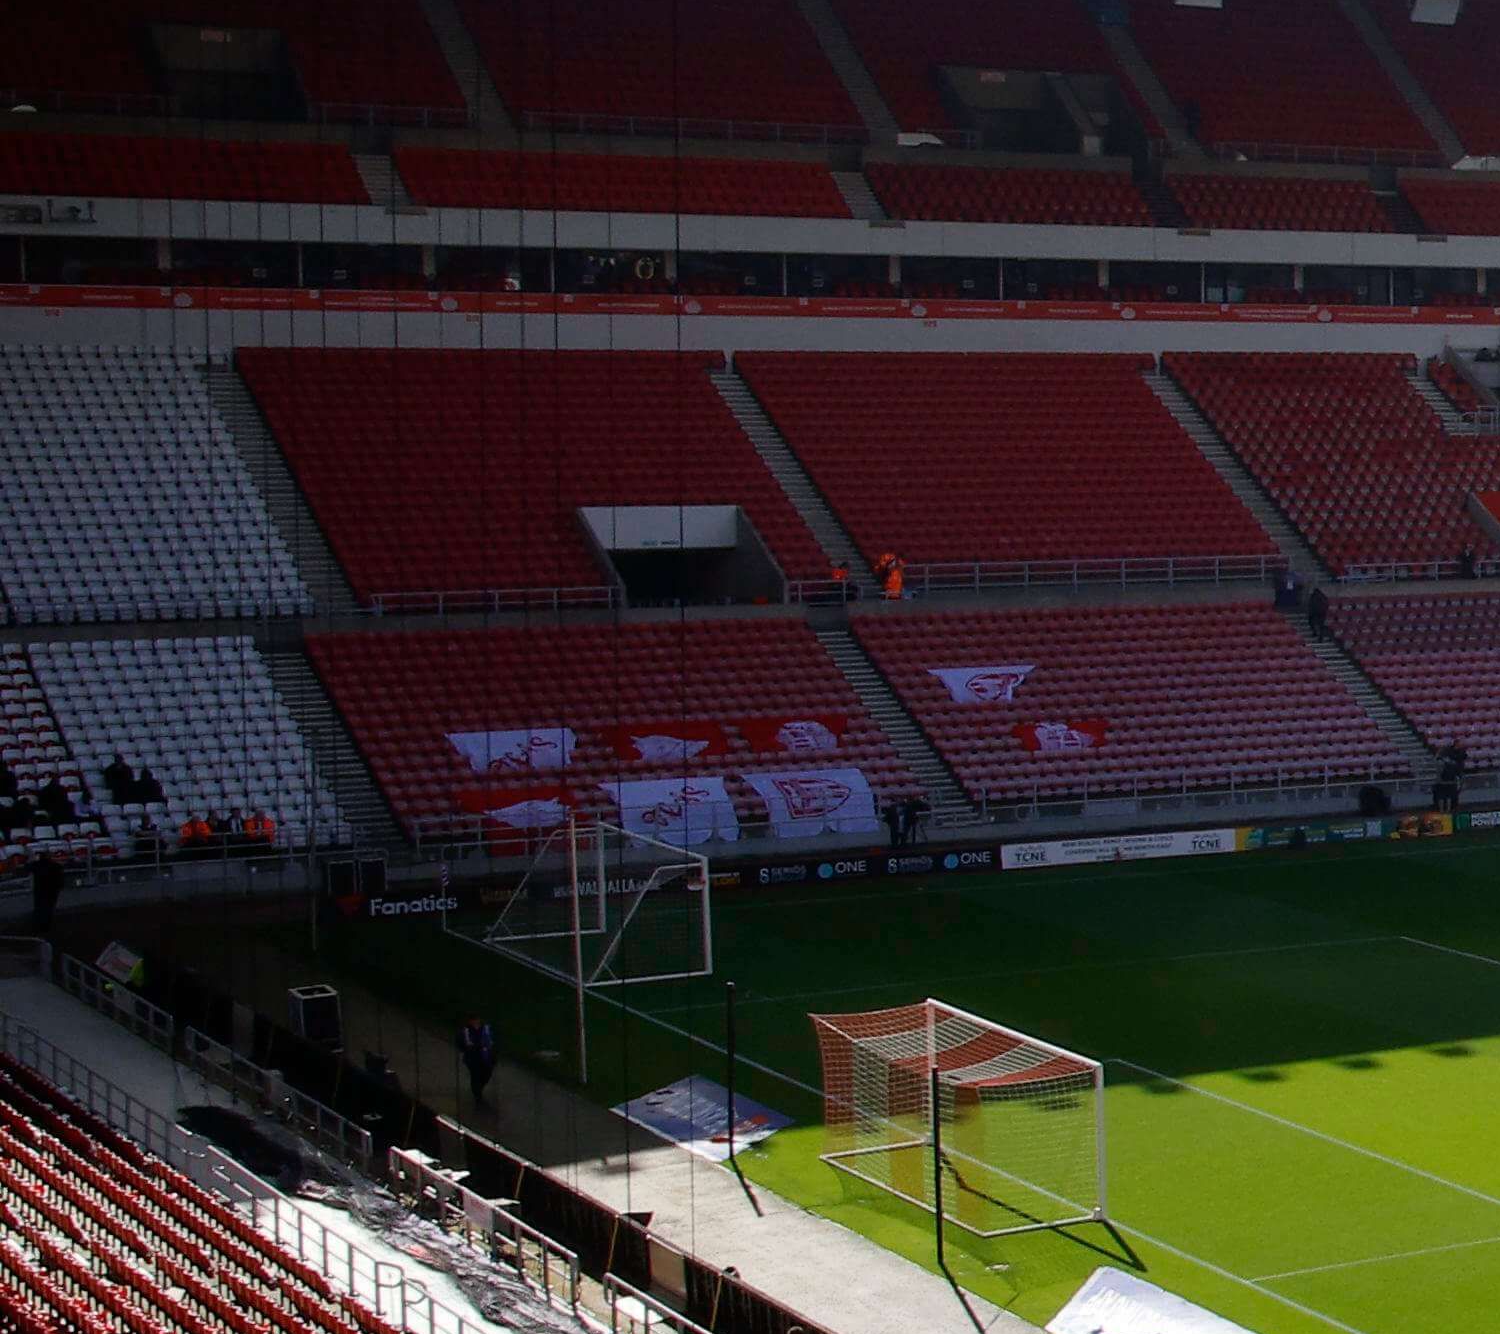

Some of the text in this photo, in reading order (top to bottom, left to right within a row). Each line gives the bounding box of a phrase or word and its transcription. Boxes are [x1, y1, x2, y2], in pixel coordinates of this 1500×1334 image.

[960, 851, 992, 865] ONE
[1015, 851, 1047, 863] TCNE
[834, 860, 867, 875] ONE
[369, 895, 459, 917] Fanatics
